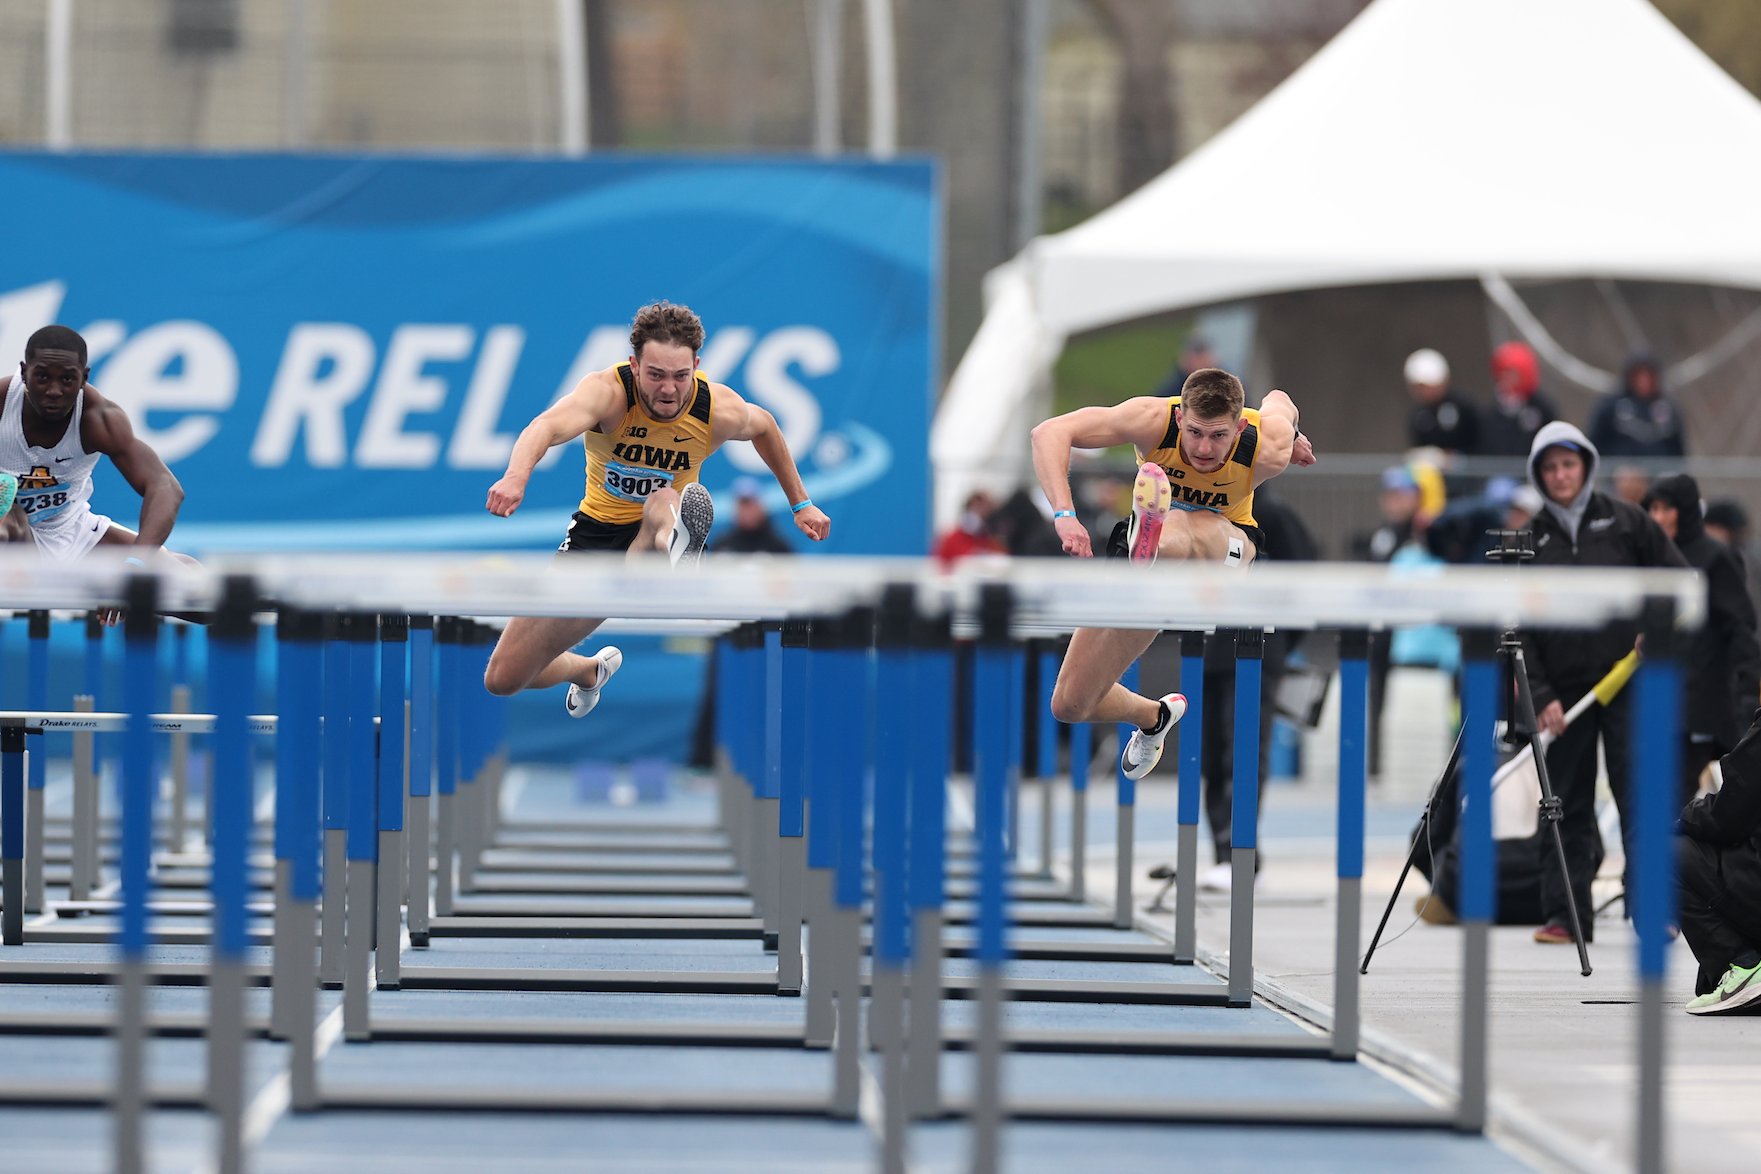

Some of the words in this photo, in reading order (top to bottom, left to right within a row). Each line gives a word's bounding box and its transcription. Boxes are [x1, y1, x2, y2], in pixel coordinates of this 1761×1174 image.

[613, 443, 690, 471] IOWA
[14, 492, 67, 514] 238
[1169, 482, 1230, 507] OWA
[39, 718, 70, 727] Drake
